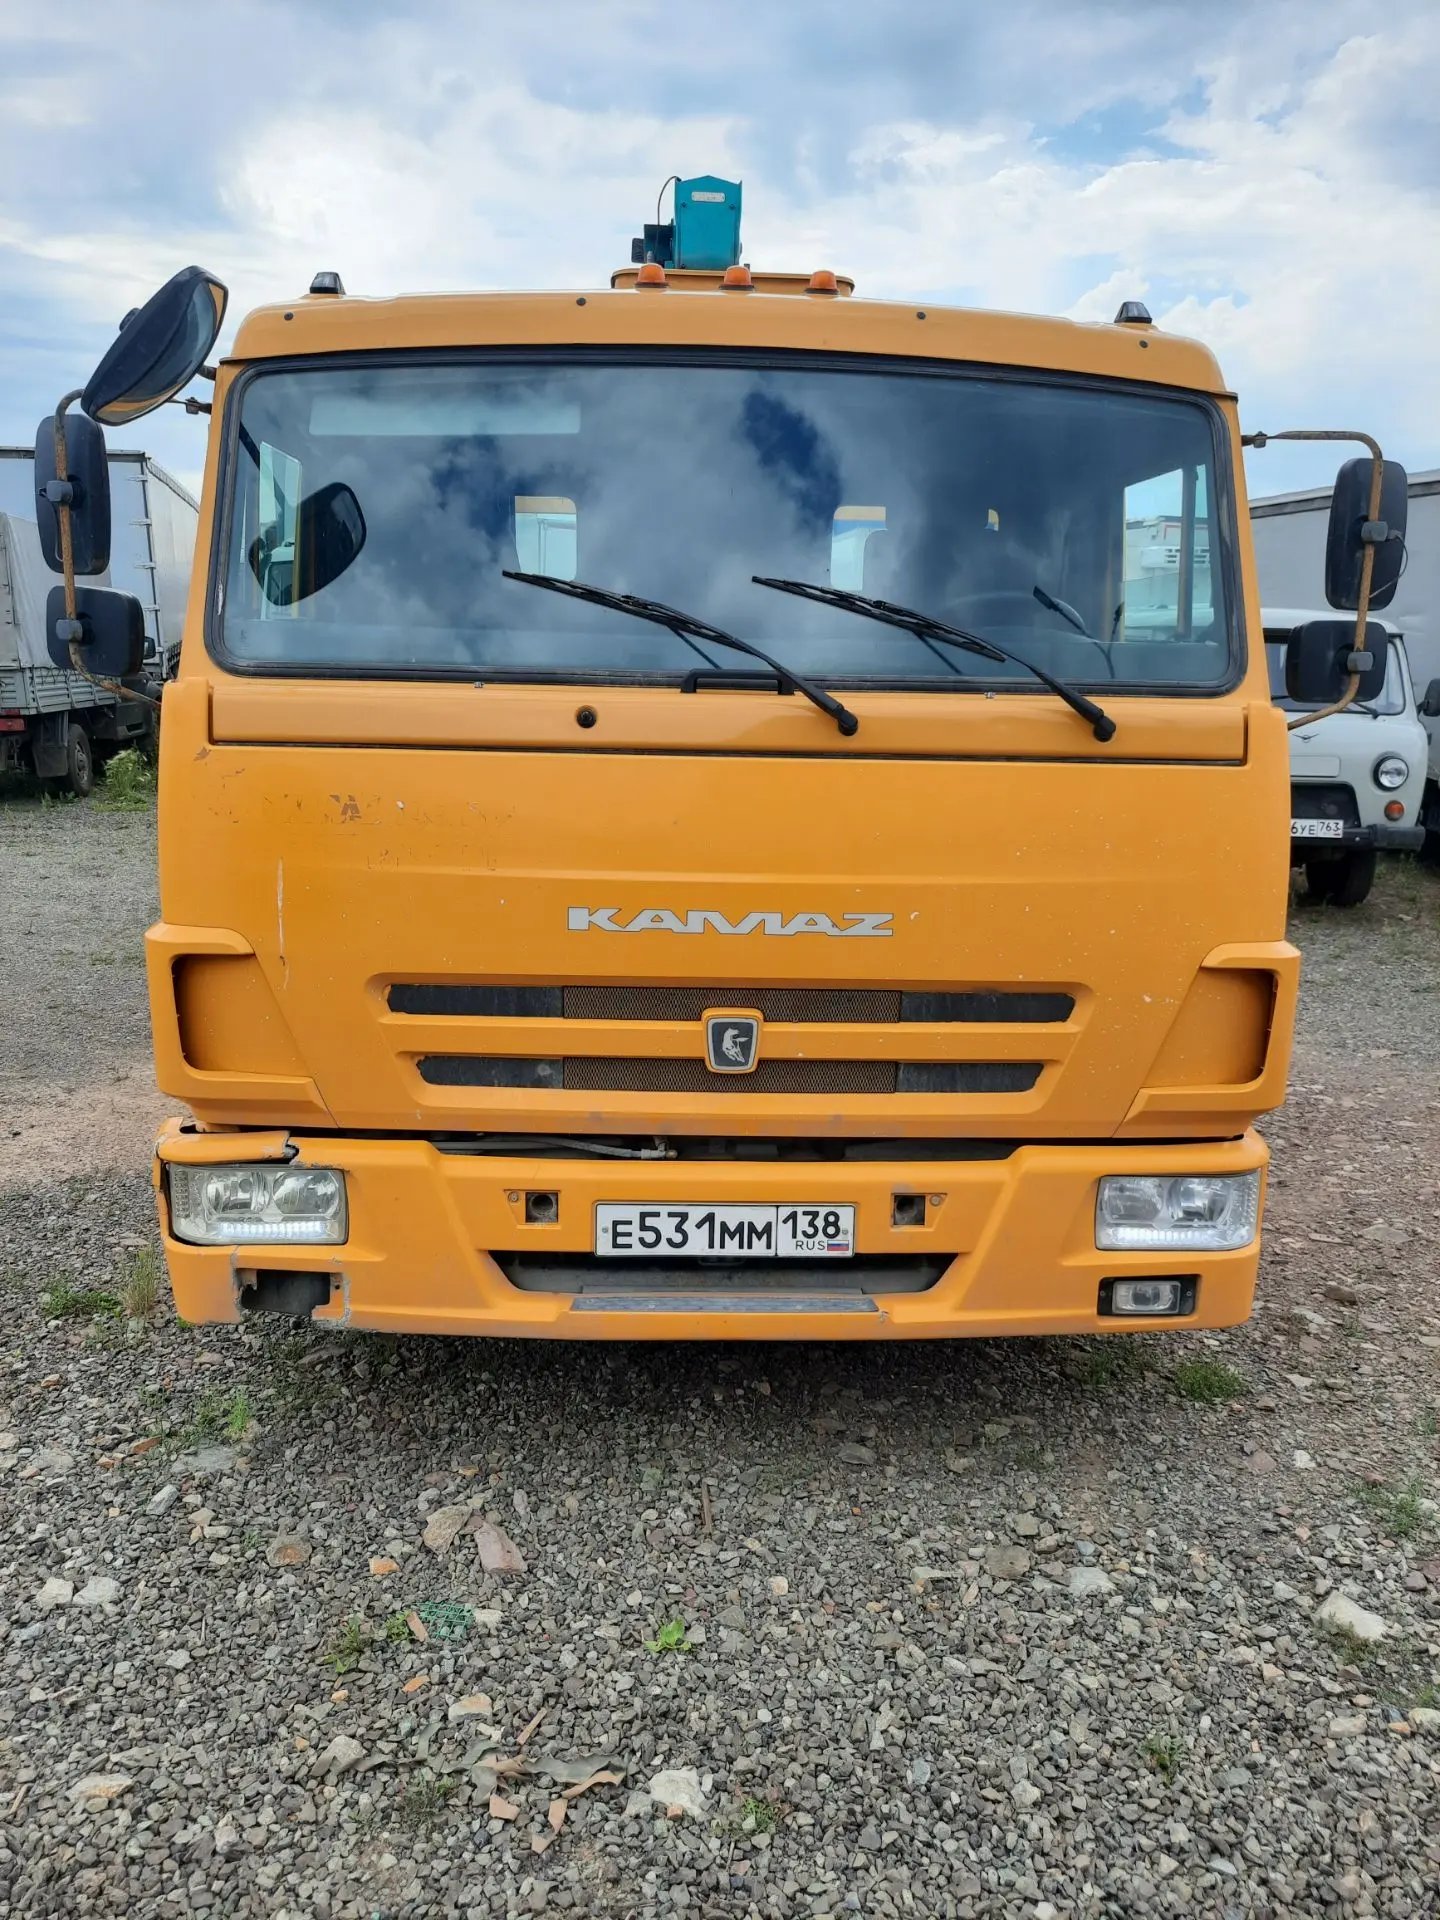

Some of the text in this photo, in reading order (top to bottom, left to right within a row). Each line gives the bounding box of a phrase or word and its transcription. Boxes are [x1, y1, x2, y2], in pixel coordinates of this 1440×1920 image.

[1319, 821, 1340, 832] 763
[567, 907, 894, 936] KAMAZ
[782, 1210, 840, 1240] 138
[796, 1240, 825, 1251] RUS
